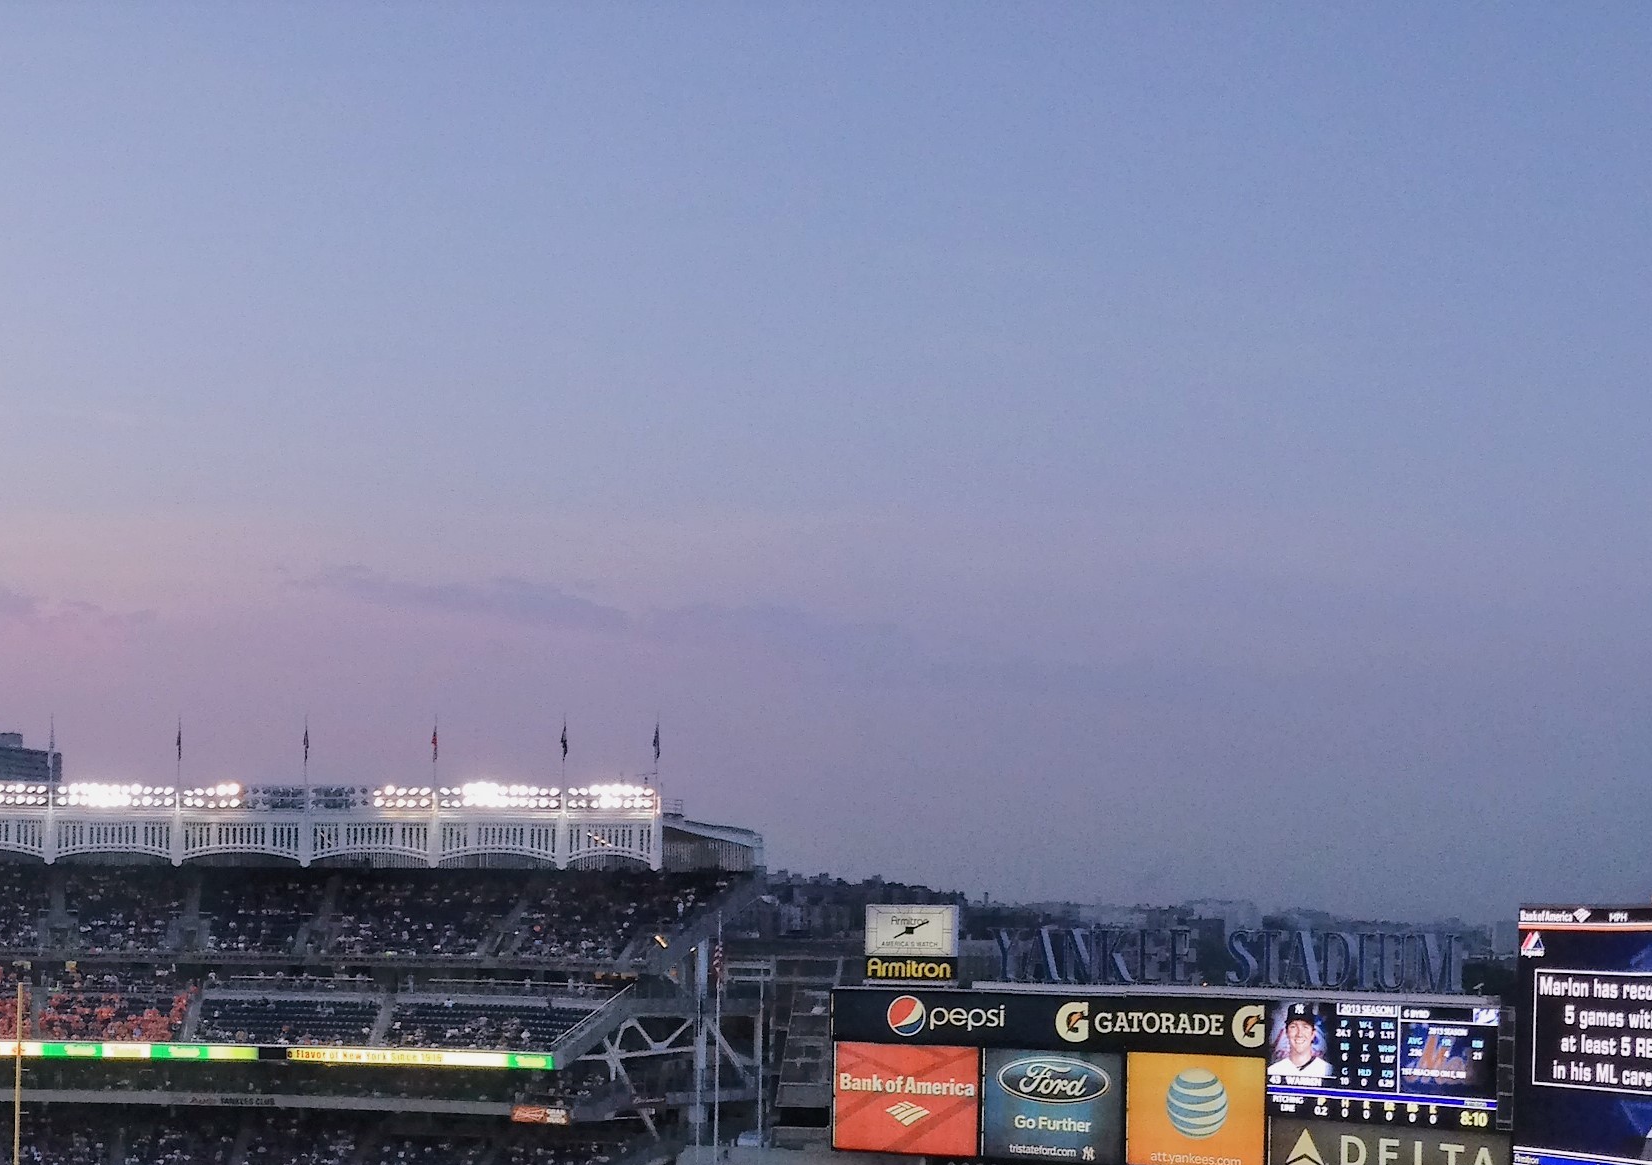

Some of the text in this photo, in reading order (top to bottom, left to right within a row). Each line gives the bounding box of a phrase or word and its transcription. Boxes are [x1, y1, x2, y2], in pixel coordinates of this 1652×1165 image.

[1608, 912, 1628, 923] MPH
[866, 957, 952, 979] Armitron
[994, 927, 1465, 993] YANKEE STADIUM
[1540, 976, 1588, 998] Marlon
[1593, 978, 1618, 999] has
[929, 1004, 1006, 1032] pepsi
[1341, 1004, 1395, 1015] 2013 SEASON
[1564, 1005, 1574, 1025] 5
[1580, 1009, 1624, 1030] games
[1095, 1012, 1224, 1036] GATORADE
[1561, 1037, 1576, 1053] at
[1581, 1037, 1616, 1056] least
[1621, 1038, 1631, 1057] 5
[1019, 1062, 1087, 1097] Ford
[1553, 1060, 1566, 1079] in
[1571, 1061, 1591, 1082] his
[1596, 1063, 1618, 1084] ML
[839, 1072, 975, 1097] Bank of America
[1014, 1115, 1091, 1133] Go Further
[1460, 1111, 1488, 1127] 8:10
[1009, 1144, 1076, 1158] tristateford.com
